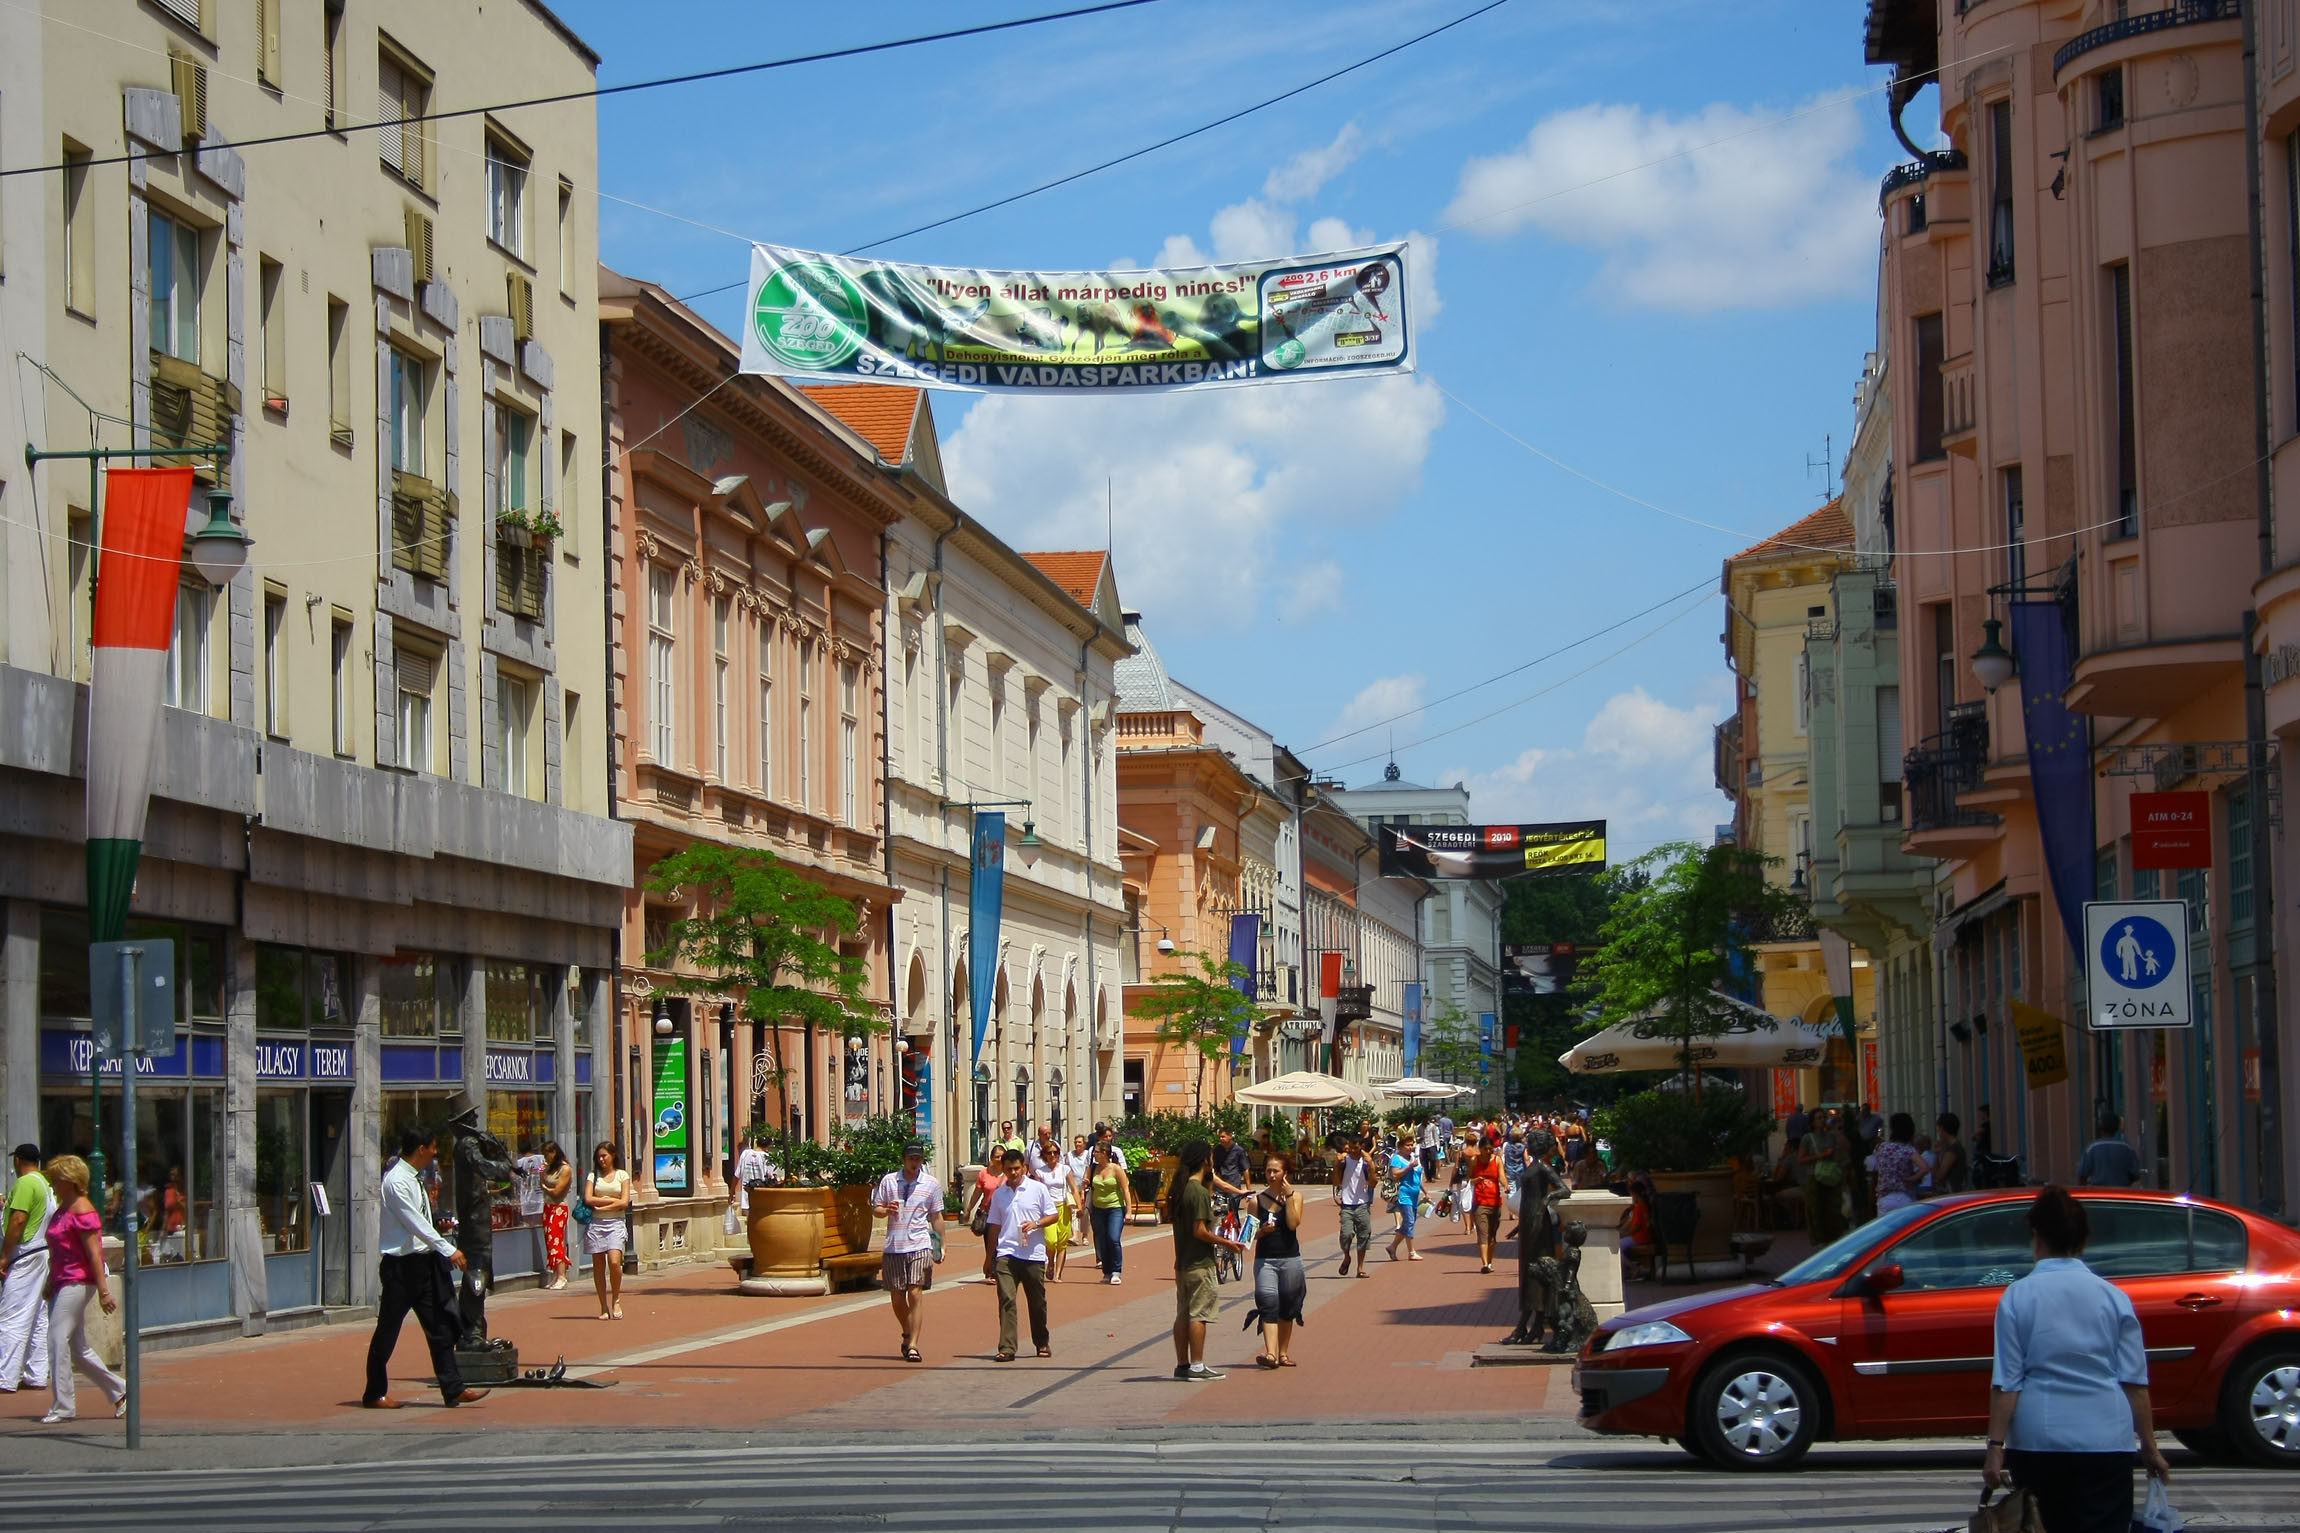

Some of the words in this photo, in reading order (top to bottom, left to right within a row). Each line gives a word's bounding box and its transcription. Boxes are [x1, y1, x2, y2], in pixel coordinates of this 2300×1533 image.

[1305, 271, 1329, 285] 2,6
[1334, 266, 1358, 278] km
[1000, 283, 1050, 301] állat
[1058, 282, 1167, 304] márpedig
[1175, 275, 1257, 299] nincs!"
[781, 315, 837, 341] ZOO
[777, 336, 836, 353] SZEGED
[1127, 352, 1156, 363] meg
[1194, 350, 1202, 358] a
[856, 354, 988, 385] SZEGEDI
[997, 360, 1257, 387] VADASPARKBAN!
[2148, 812, 2168, 823] ATM
[2170, 811, 2193, 821] 0-24
[1427, 832, 1476, 842] SZEGEDI
[1491, 832, 1512, 842] 2010
[2105, 998, 2174, 1018] ZÓNA
[1283, 1020, 1318, 1031] ATRIUM
[315, 1048, 347, 1076] TEREM
